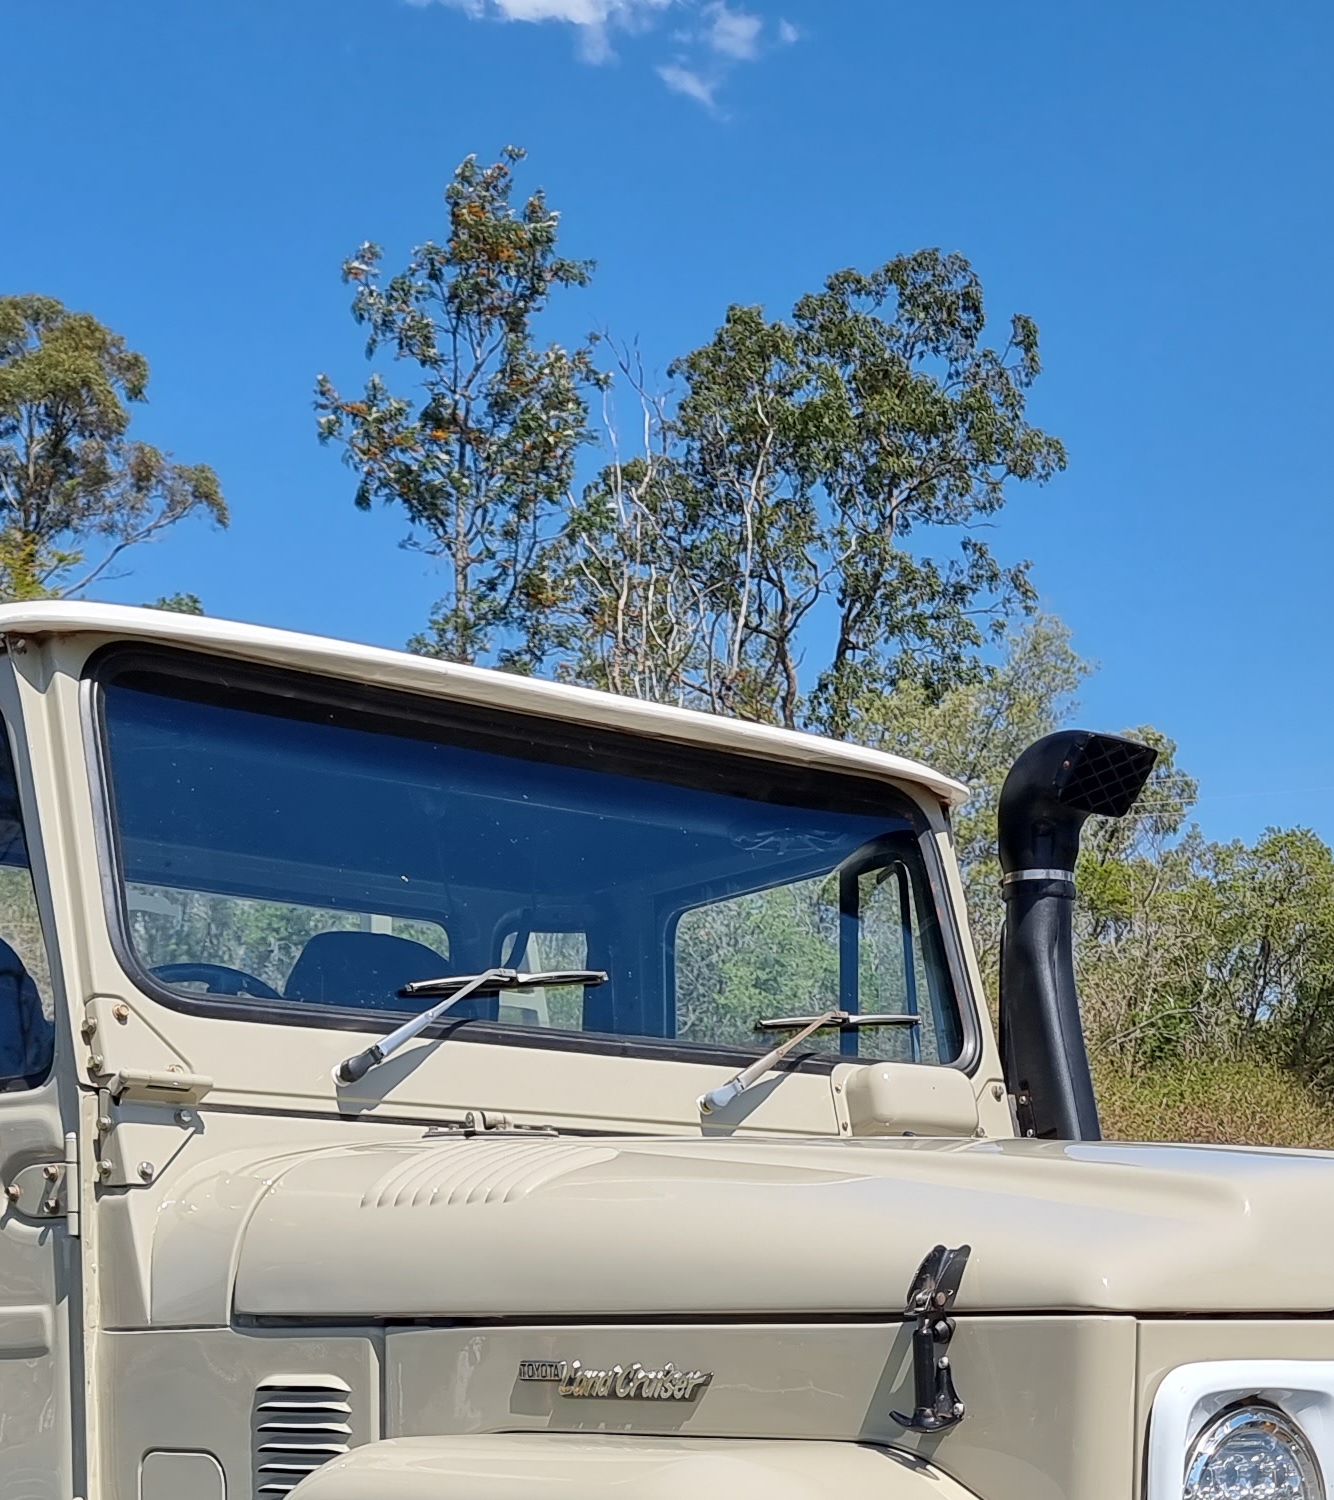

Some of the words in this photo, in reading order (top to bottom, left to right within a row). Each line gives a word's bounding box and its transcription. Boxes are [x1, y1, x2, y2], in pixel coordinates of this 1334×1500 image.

[519, 1363, 560, 1379] TOYOTA
[558, 1360, 622, 1397] Land
[617, 1362, 714, 1399] Cruiser
